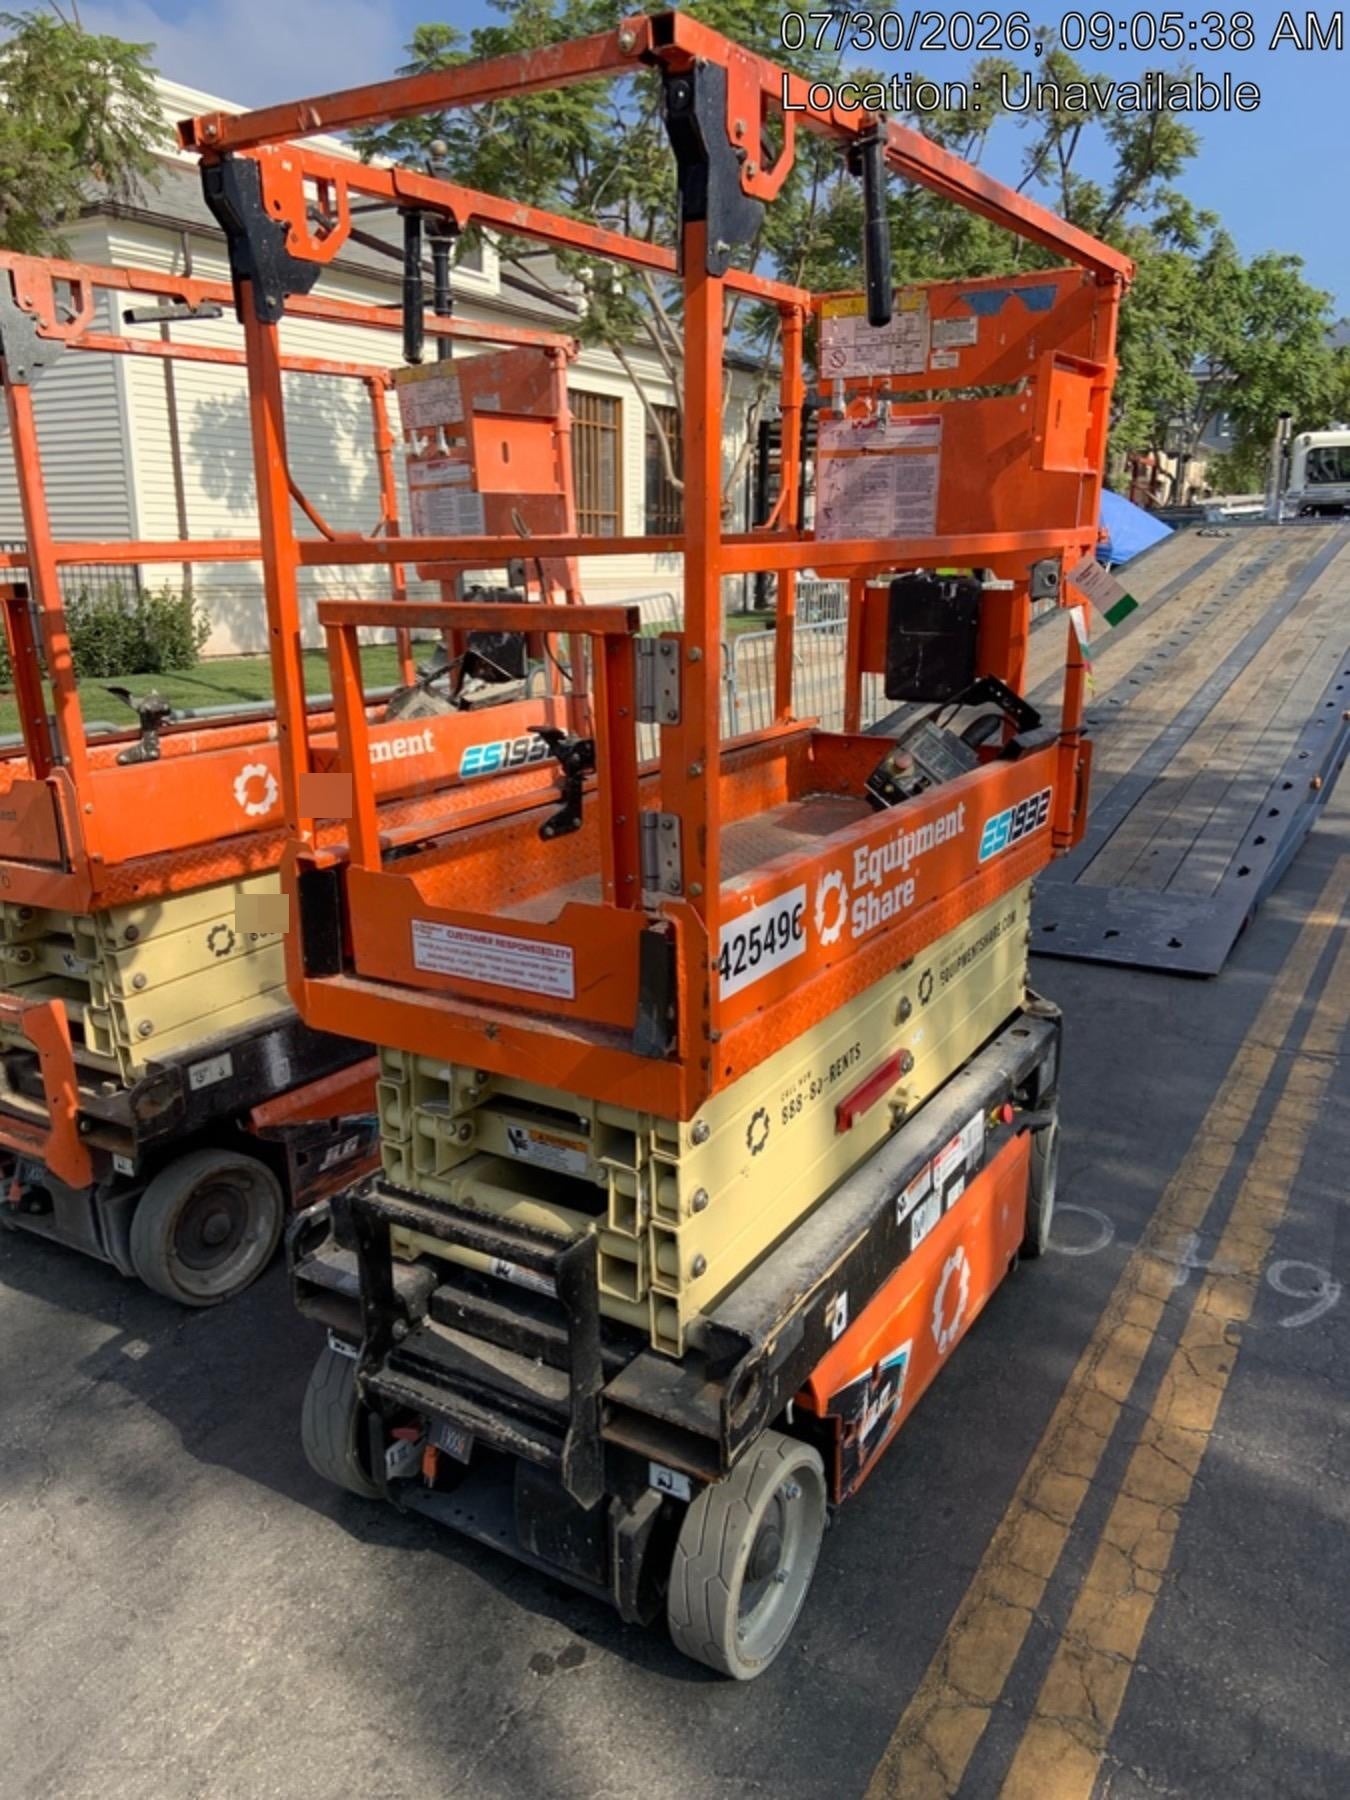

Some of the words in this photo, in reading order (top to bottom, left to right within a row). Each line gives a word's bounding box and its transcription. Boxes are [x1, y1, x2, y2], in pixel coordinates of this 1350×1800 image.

[460, 735, 553, 777] ES193
[853, 801, 965, 890] Equipment
[979, 788, 1052, 860] ES1932
[446, 929, 493, 945] CUSTOMER
[851, 877, 915, 938] Share
